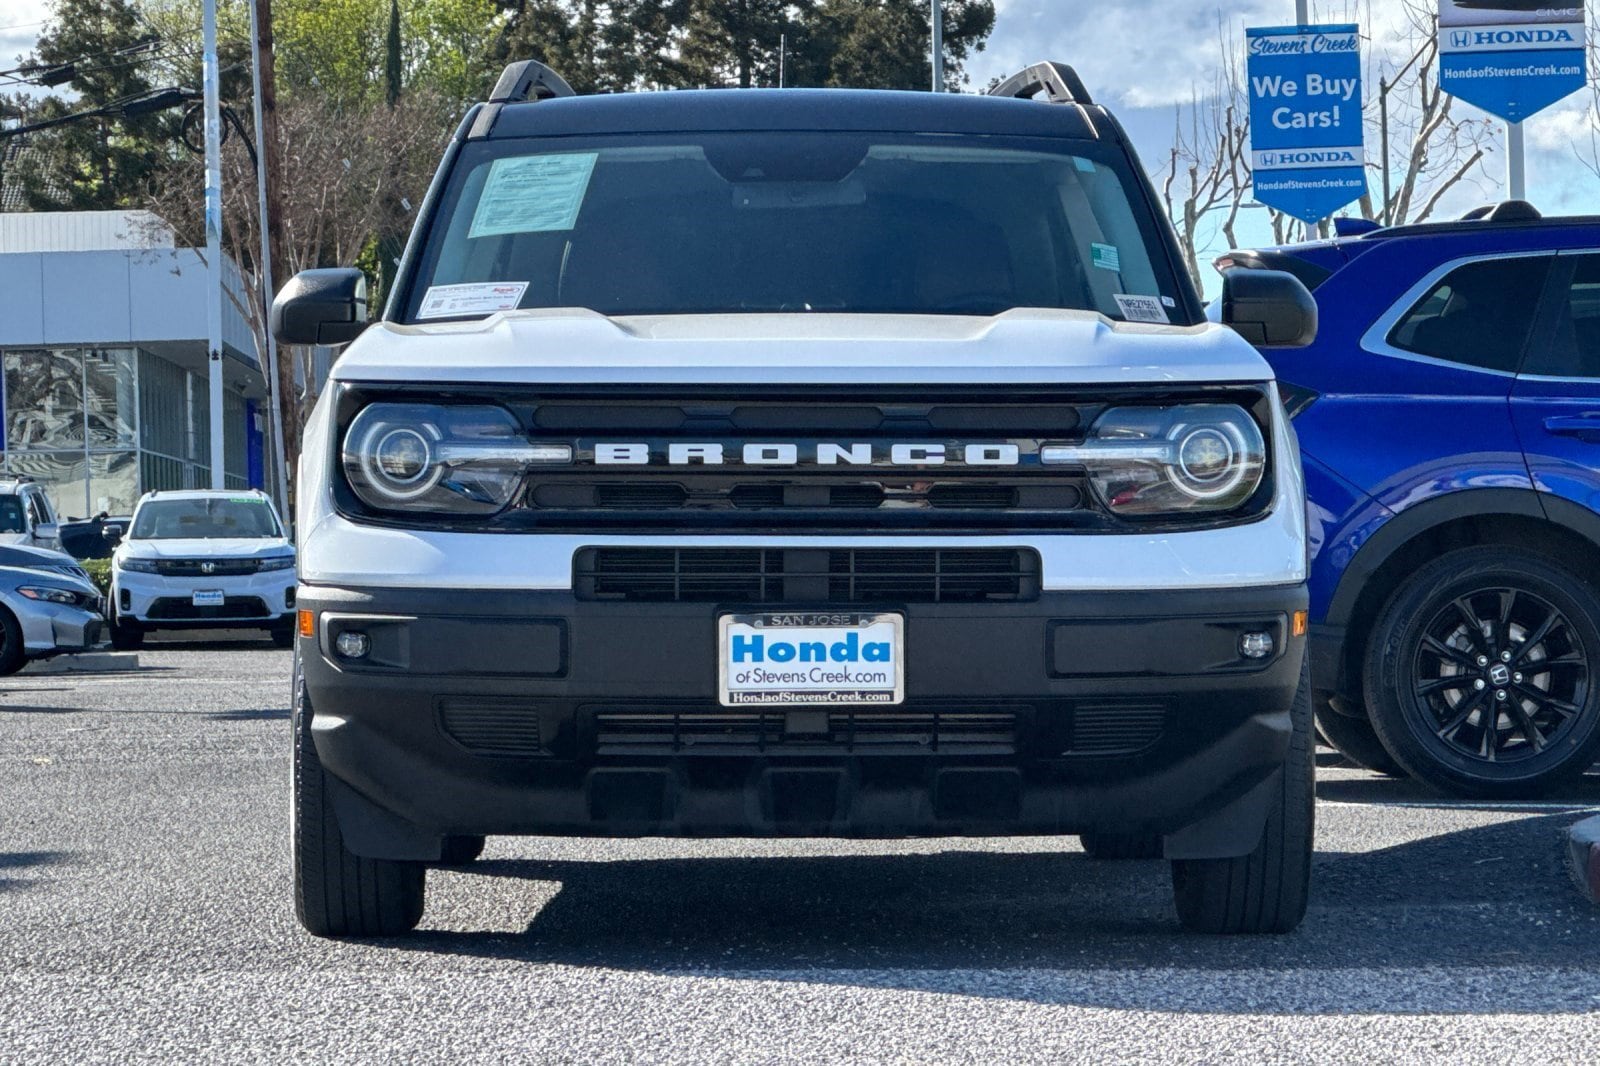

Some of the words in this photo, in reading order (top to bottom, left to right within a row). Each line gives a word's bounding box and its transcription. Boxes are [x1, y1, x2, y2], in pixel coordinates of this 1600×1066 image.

[1535, 8, 1578, 17] CIVIC
[1249, 36, 1306, 56] Stevens
[1311, 33, 1358, 53] Creek
[1474, 29, 1574, 44] HONDA
[1444, 65, 1580, 79] HondaofStevensCreek.com
[1252, 75, 1298, 98] We
[1306, 73, 1357, 101] Buy
[1272, 105, 1340, 129] Cars!
[1279, 151, 1356, 164] HONDA
[1257, 178, 1362, 191] HondaofStevensCreek.com
[594, 443, 1019, 465] BRONCO
[771, 615, 804, 626] SAN
[808, 614, 851, 625] JOSE
[732, 632, 890, 663] Honda
[735, 670, 751, 684] of
[753, 667, 806, 683] Stevens
[809, 665, 886, 683] Creek.com
